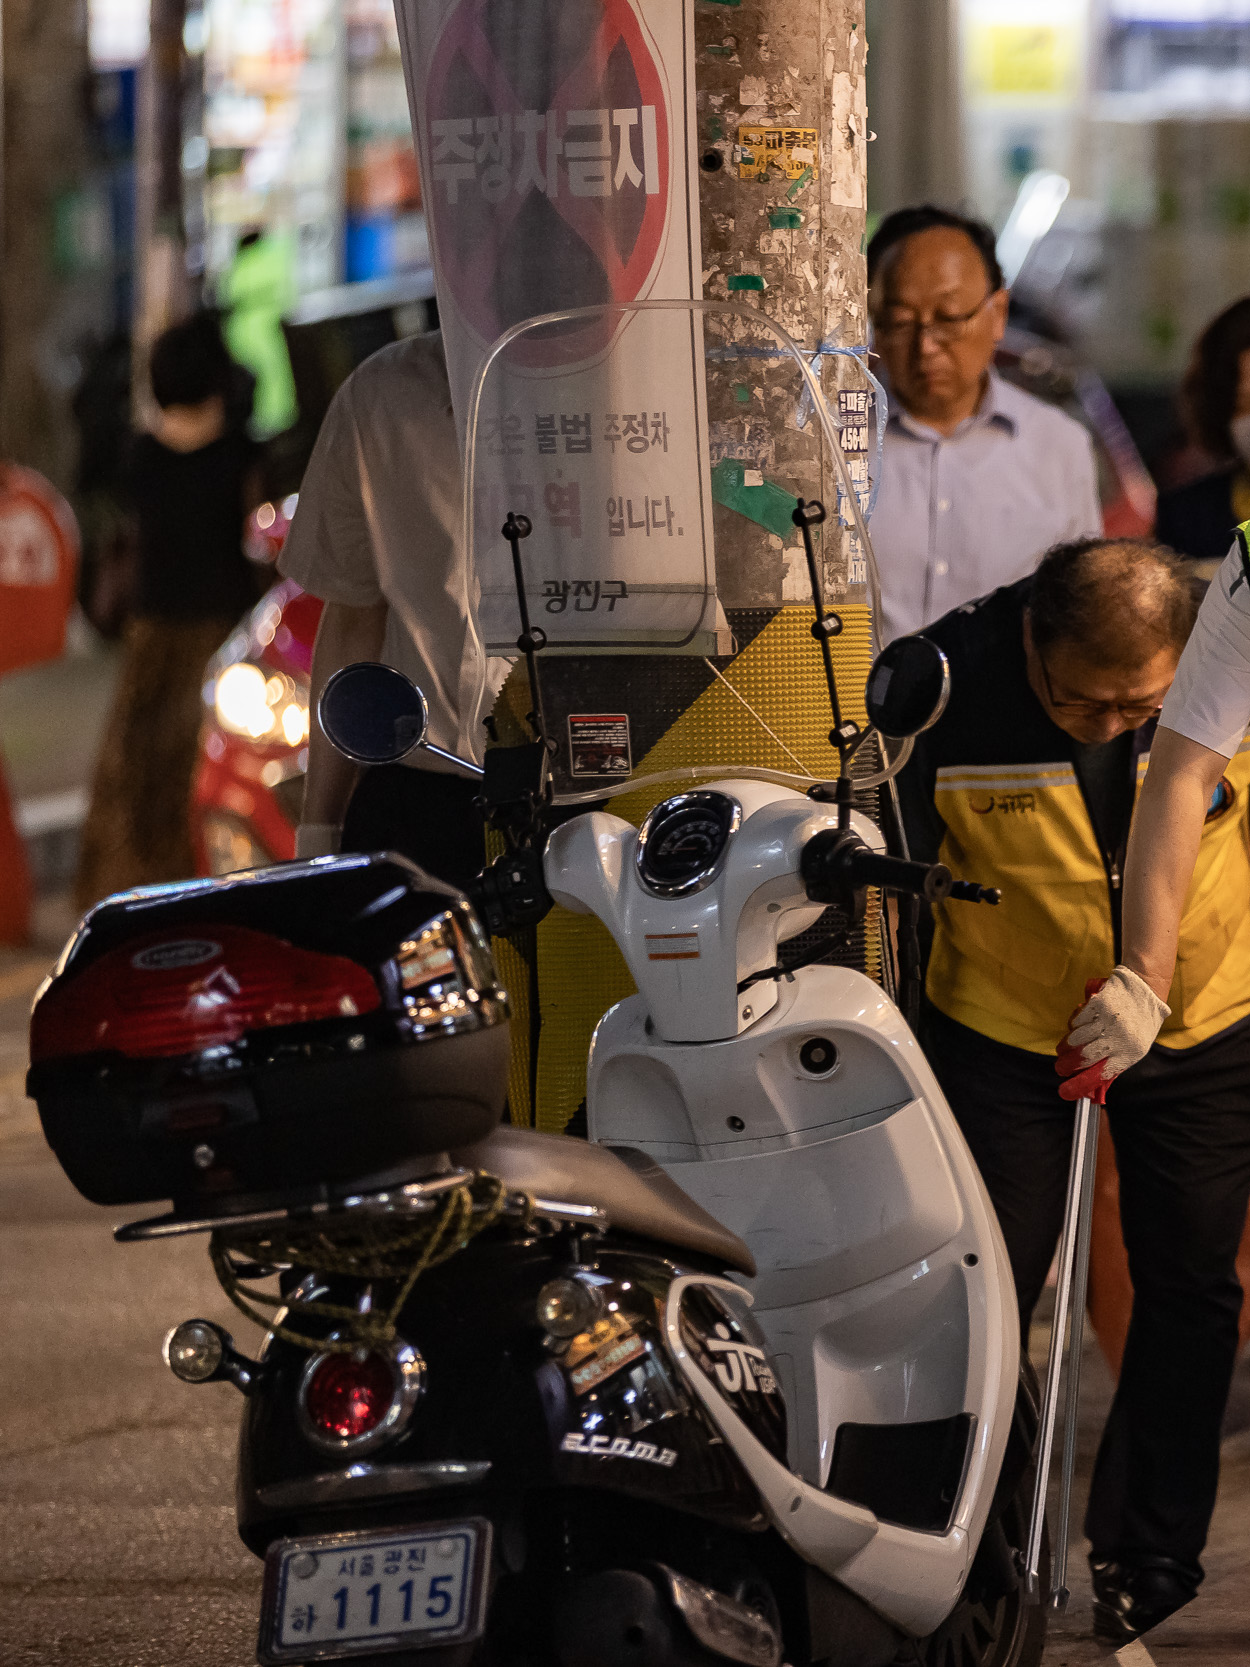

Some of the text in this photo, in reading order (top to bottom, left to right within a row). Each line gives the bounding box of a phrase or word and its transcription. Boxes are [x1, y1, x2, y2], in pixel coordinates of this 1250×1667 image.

[535, 412, 593, 455] 불법
[603, 412, 670, 453] 주정차
[606, 495, 685, 537] 입니다.
[541, 580, 629, 613] 광진구
[338, 1548, 427, 1578] 서울 광진
[290, 1574, 454, 1634] 하 1115
